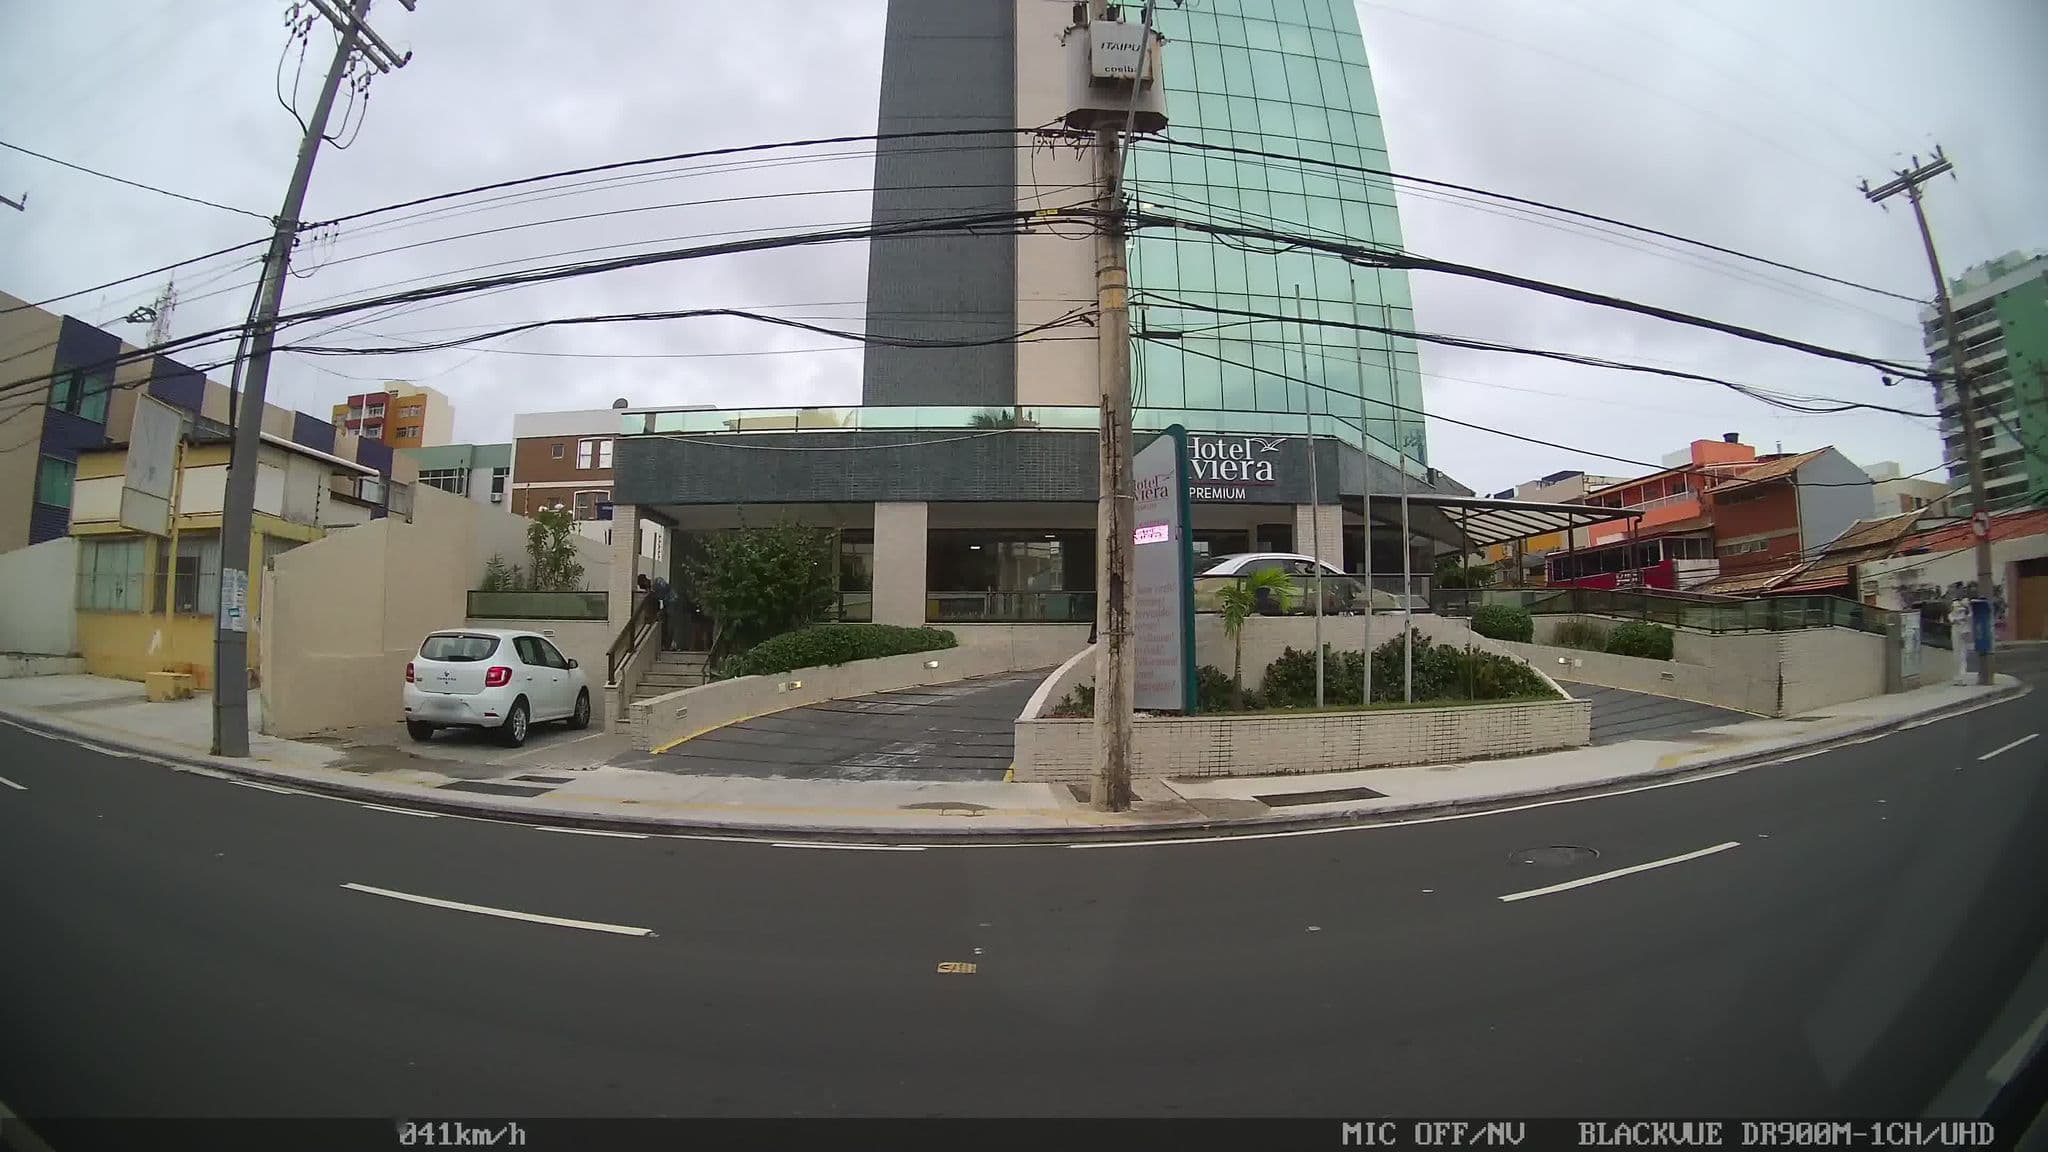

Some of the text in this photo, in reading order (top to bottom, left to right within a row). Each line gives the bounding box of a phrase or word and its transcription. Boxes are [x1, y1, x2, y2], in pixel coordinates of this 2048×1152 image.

[1101, 41, 1141, 52] ITAIPU
[1104, 65, 1137, 73] coelb
[1187, 437, 1254, 460] Hotel
[1188, 459, 1275, 481] viera
[1189, 486, 1246, 500] PREMIUM
